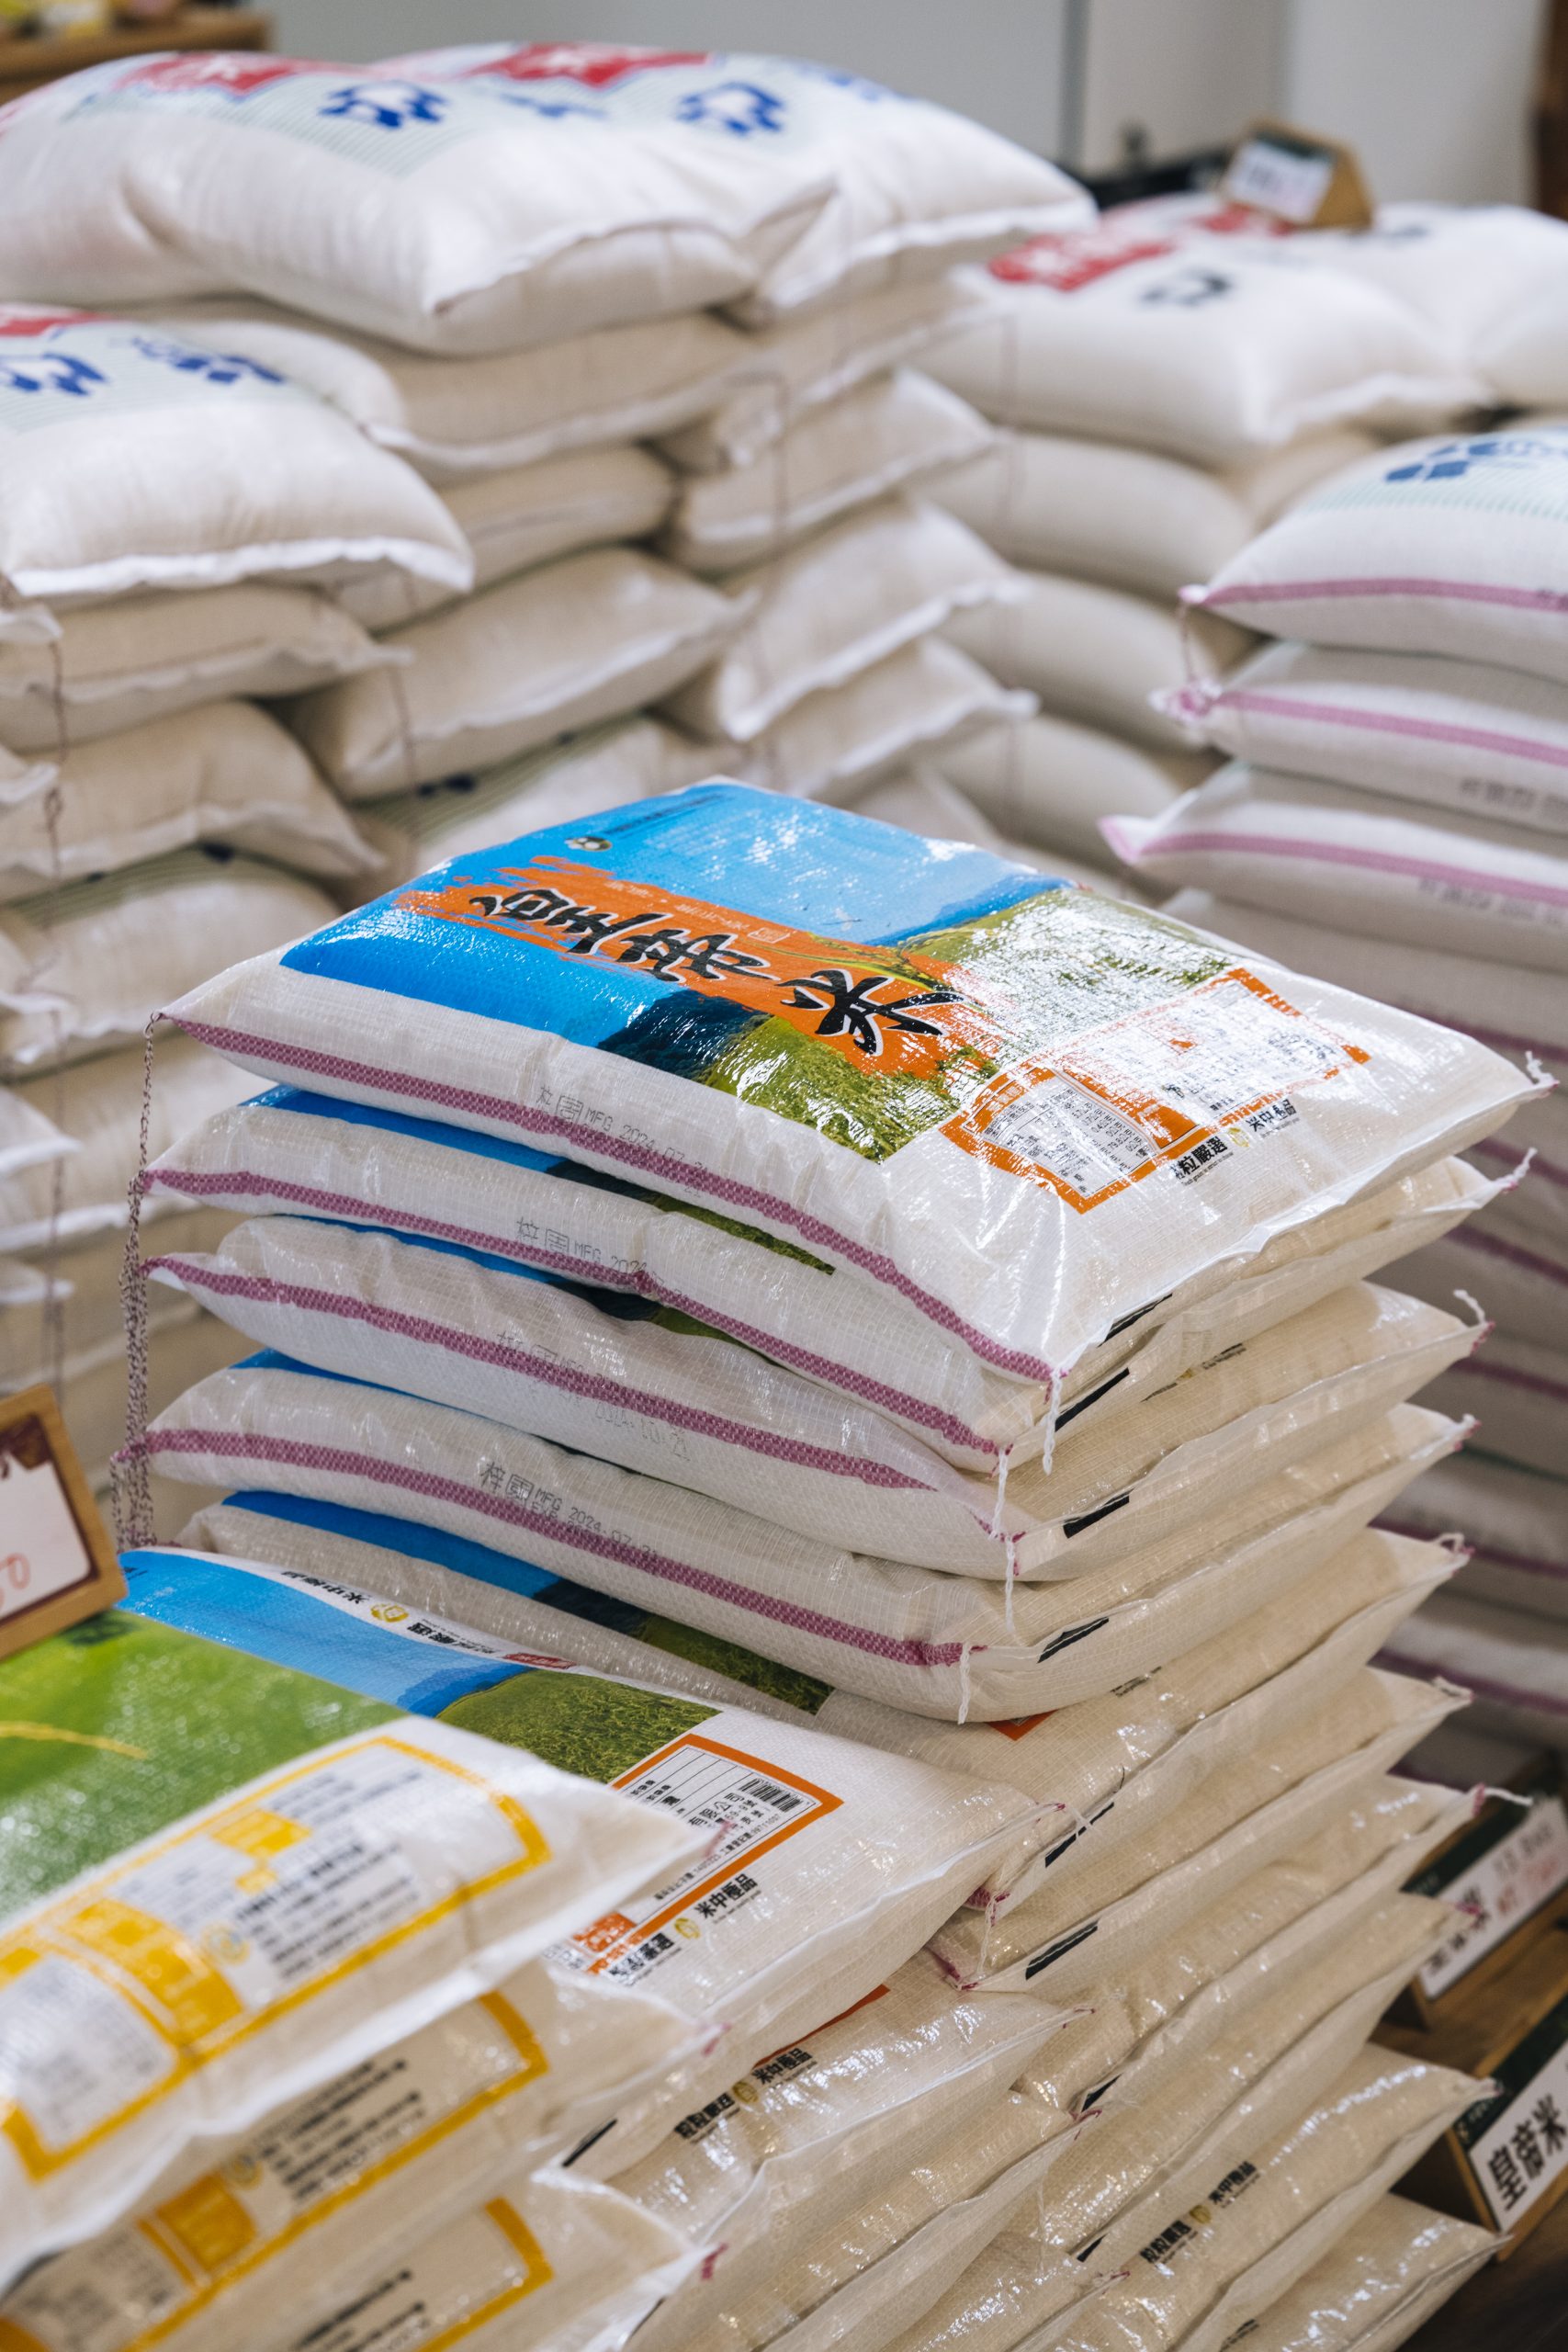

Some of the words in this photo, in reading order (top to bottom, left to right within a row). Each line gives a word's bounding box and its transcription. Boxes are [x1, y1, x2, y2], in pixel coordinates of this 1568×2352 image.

[469, 888, 965, 1056] 皇帝米
[585, 1106, 614, 1132] MFG
[574, 1241, 602, 1262] MFG
[536, 1487, 563, 1512] MFG
[1488, 2093, 1567, 2211] 皇帝米
